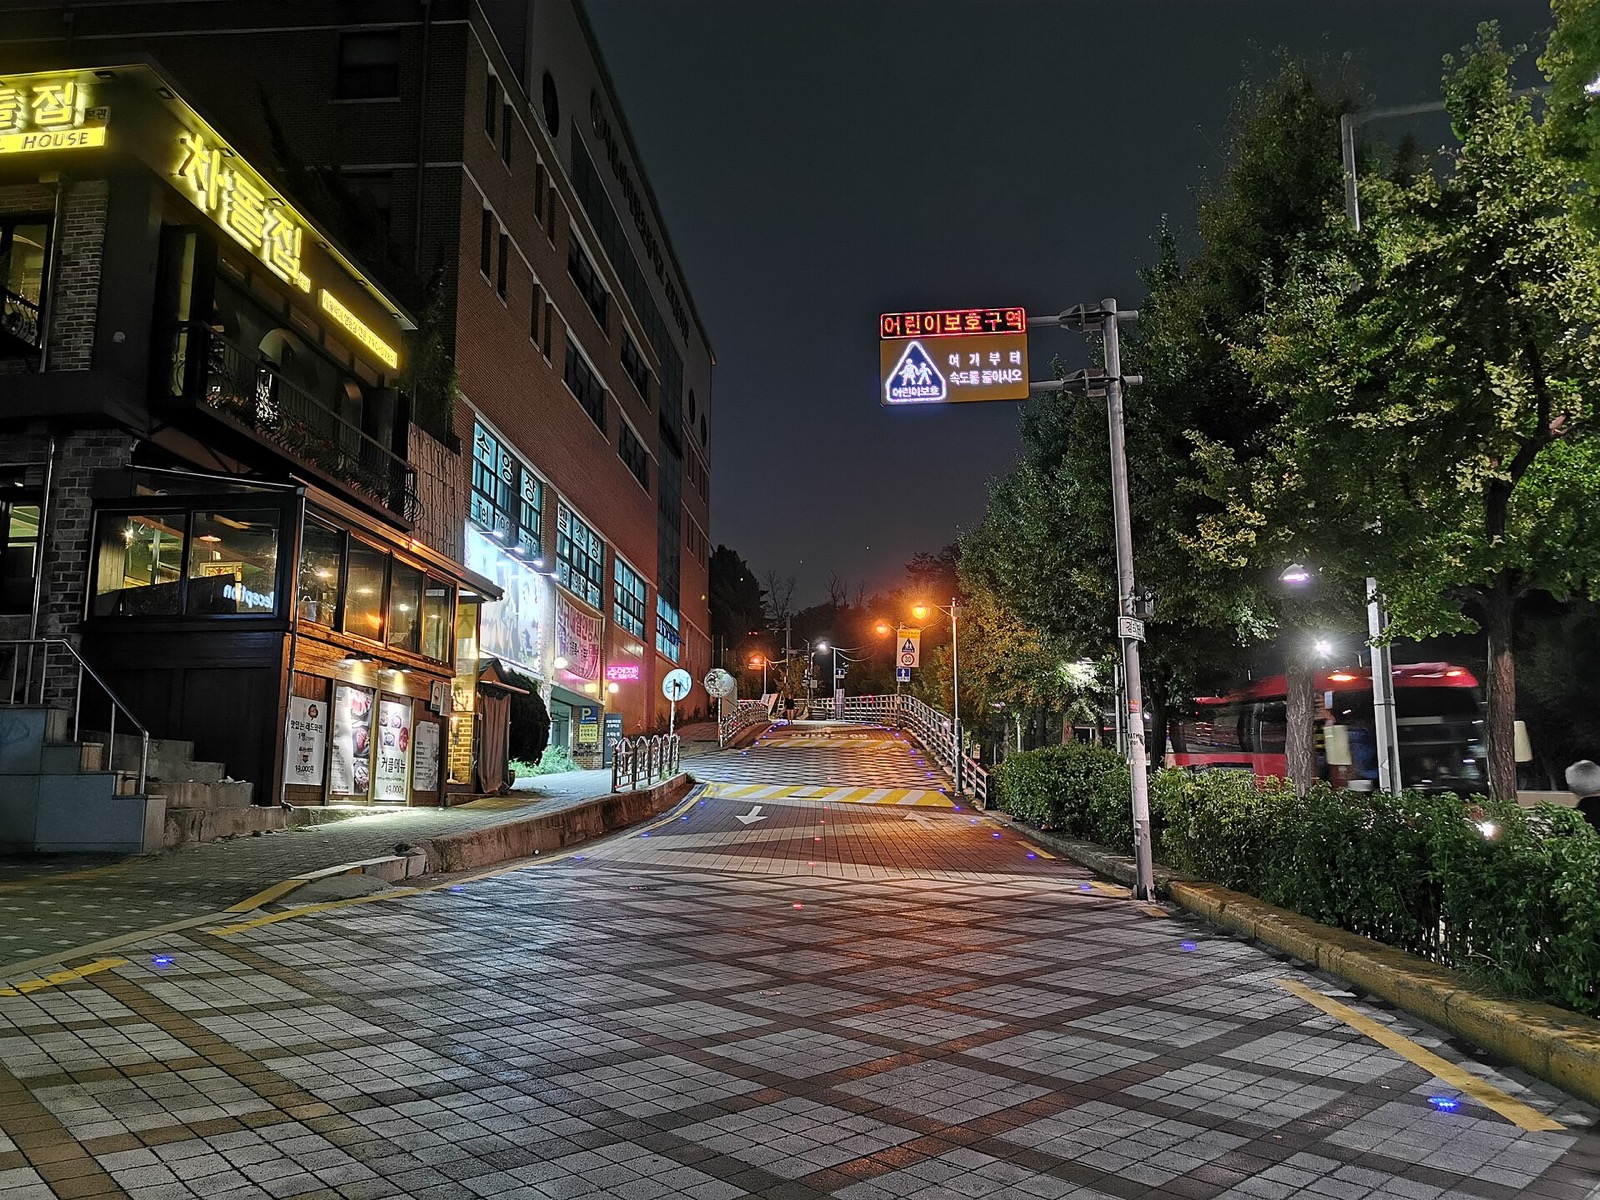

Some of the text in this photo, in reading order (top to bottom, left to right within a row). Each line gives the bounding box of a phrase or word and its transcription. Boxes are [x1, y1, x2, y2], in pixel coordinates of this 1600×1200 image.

[22, 132, 88, 149] HOUSE
[183, 133, 302, 280] 차돌집
[884, 311, 1022, 335] 어린이보호구역
[949, 369, 1022, 386] 속도를 줄이시오
[892, 386, 940, 397] 어린이보호
[477, 433, 536, 503] 수영장
[477, 498, 490, 525] Tel
[558, 504, 600, 560] 헬스장
[904, 655, 912, 663] 30
[582, 707, 592, 720] P
[381, 756, 406, 774] 커플메뉴
